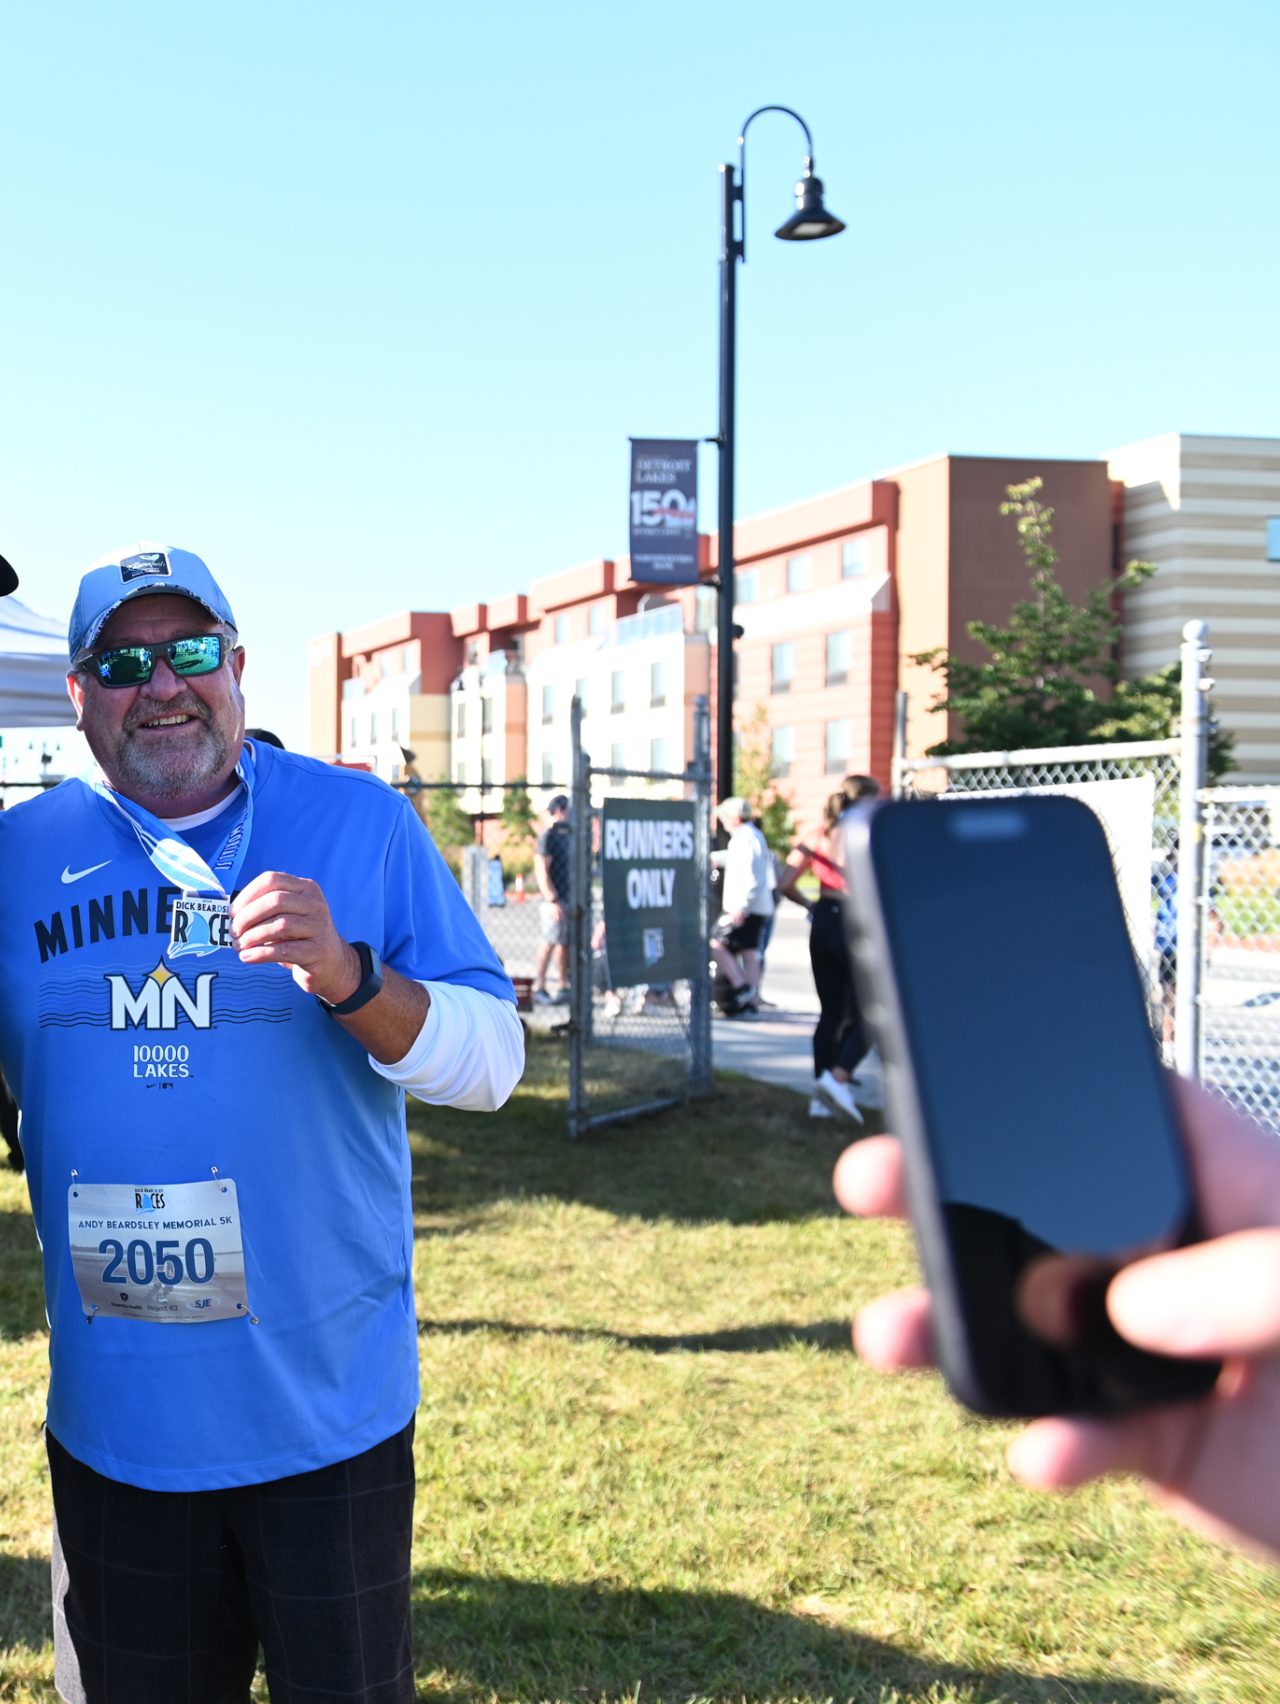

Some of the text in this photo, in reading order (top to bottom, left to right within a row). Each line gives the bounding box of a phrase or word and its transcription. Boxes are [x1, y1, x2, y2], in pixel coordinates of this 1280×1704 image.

[636, 472, 677, 483] LAKES
[605, 819, 694, 860] RUNNERS
[626, 869, 675, 909] ONLY
[176, 901, 230, 913] DICK BEARDS
[34, 887, 185, 963] MINNE
[104, 971, 218, 1030] MN
[133, 1063, 189, 1078] LAKES
[78, 1216, 233, 1230] ANDY BEARDSLEY MEMORIAL 5K
[98, 1238, 215, 1285] 2050
[195, 1298, 211, 1309] SJE
